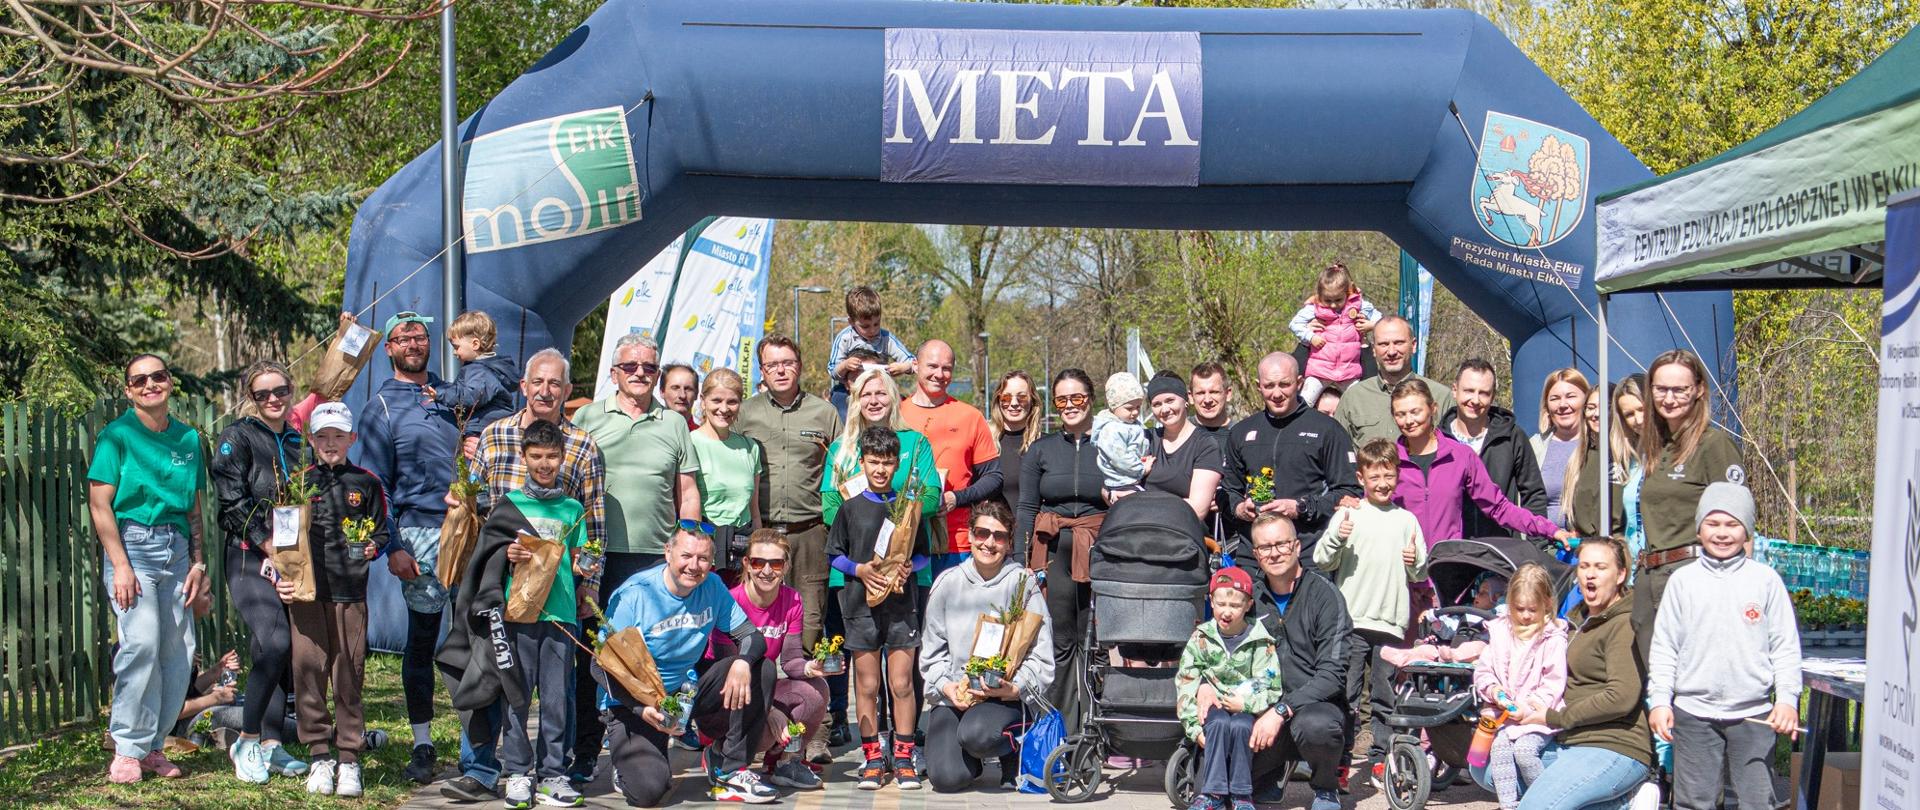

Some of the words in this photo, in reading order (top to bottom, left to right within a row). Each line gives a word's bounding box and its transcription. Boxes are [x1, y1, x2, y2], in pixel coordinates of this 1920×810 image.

[885, 68, 1199, 146] META
[1633, 223, 1681, 263] CENTRUM
[1681, 208, 1738, 251] EDUKACJI
[1740, 178, 1849, 238] EKOLOGICZNEJ
[1851, 174, 1868, 212] W
[1453, 237, 1509, 261] Prezydent
[1512, 253, 1551, 270] Miasta
[1553, 261, 1581, 275] Ełku
[1465, 252, 1493, 269] Rada
[1496, 262, 1533, 279] Miasta
[1536, 271, 1563, 286] Ełku
